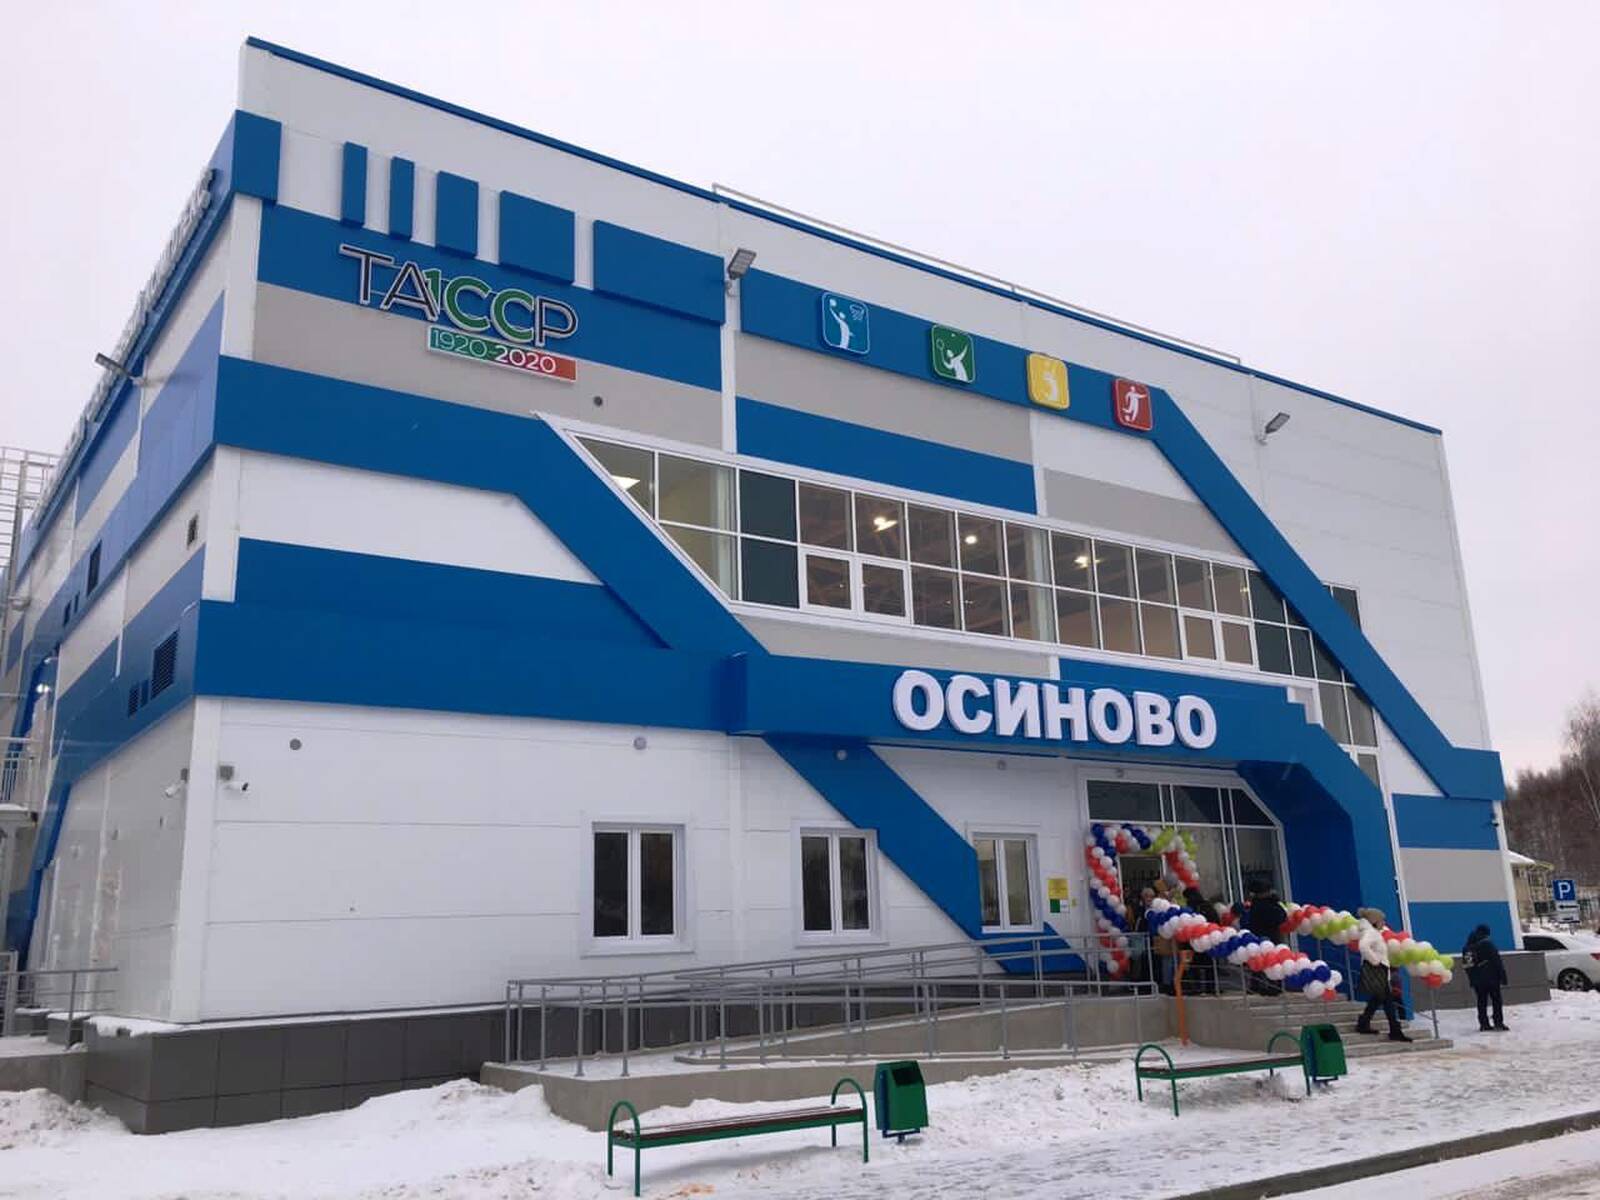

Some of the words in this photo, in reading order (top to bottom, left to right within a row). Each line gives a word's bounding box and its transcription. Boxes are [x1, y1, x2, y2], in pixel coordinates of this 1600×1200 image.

[431, 328, 556, 374] 1920-2020
[892, 670, 1217, 749] ОСИНОВО
[1558, 881, 1571, 900] P
